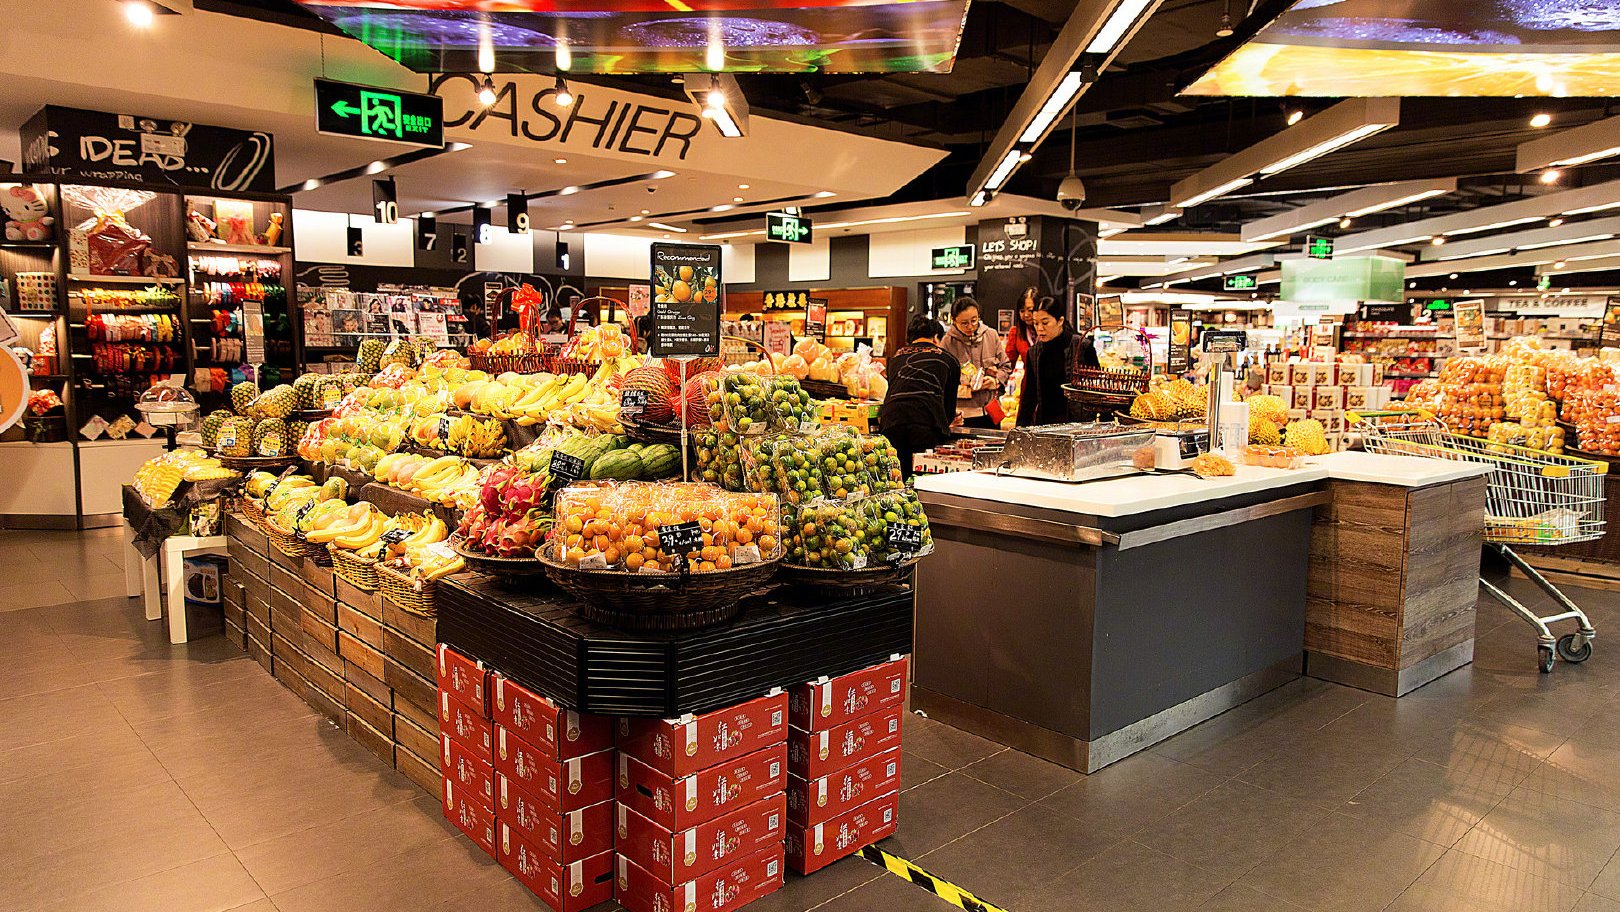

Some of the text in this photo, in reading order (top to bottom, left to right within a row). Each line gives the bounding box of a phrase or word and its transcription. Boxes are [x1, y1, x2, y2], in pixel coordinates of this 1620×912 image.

[431, 73, 702, 160] CASHIER
[405, 124, 429, 134] EXIT
[80, 170, 143, 182] wrapping
[376, 200, 398, 224] 10
[516, 212, 529, 234] 9
[424, 233, 436, 251] 7
[480, 224, 492, 245] 8
[353, 240, 363, 256] 3
[1009, 239, 1037, 252] SHOP!
[457, 248, 467, 263] 2
[561, 254, 570, 270] 1
[657, 251, 711, 261] Recommended
[1509, 300, 1529, 308] TEA
[1544, 298, 1588, 308] COFFEE
